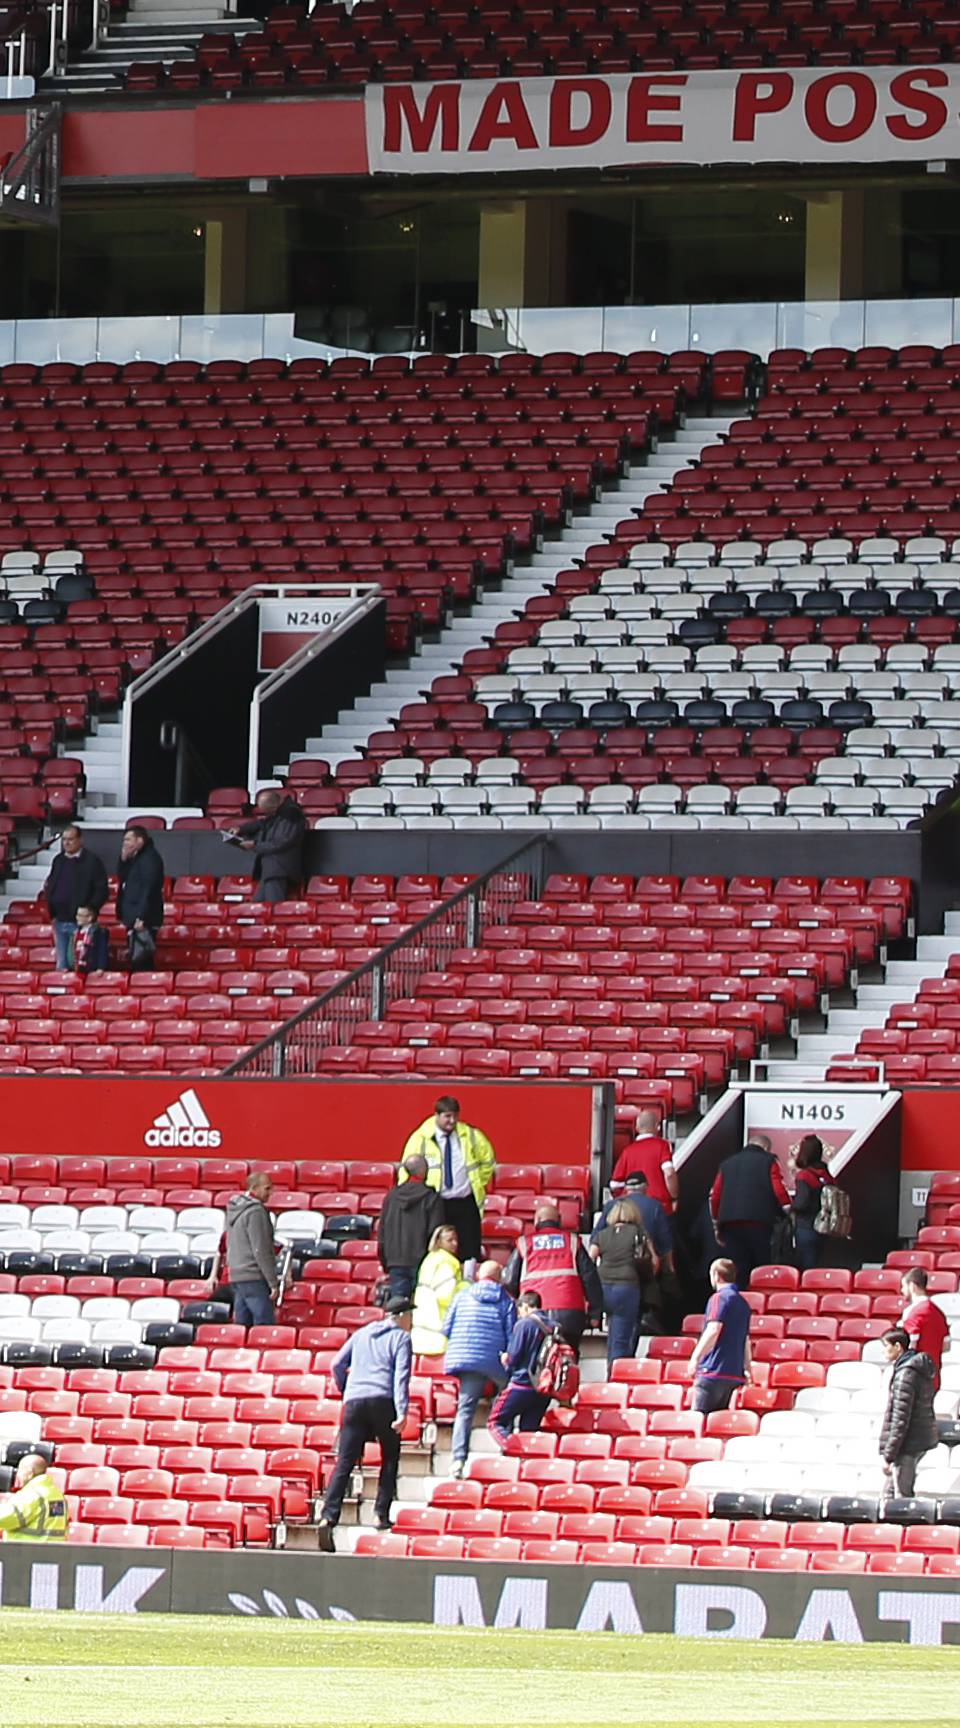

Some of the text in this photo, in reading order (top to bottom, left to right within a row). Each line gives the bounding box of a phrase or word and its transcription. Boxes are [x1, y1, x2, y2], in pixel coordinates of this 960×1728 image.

[382, 74, 689, 153] MADE
[781, 1104, 845, 1120] N1405
[145, 1126, 221, 1147] adidas
